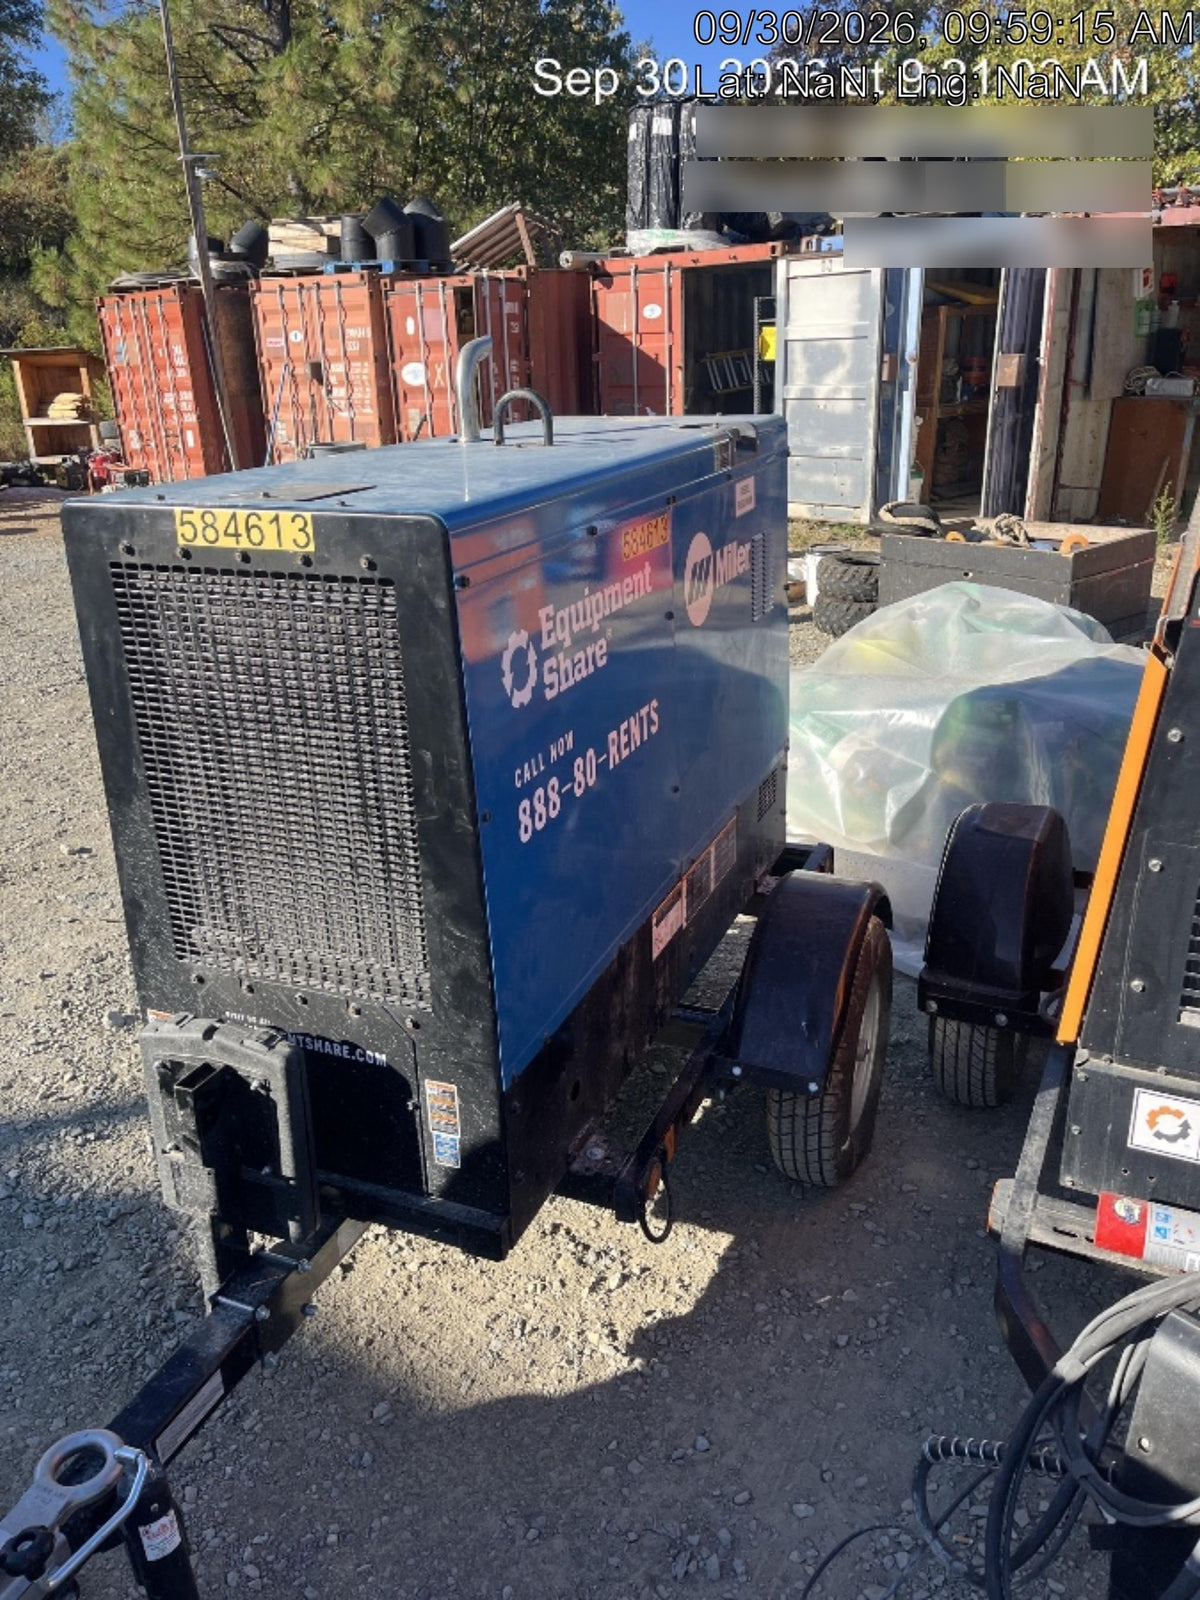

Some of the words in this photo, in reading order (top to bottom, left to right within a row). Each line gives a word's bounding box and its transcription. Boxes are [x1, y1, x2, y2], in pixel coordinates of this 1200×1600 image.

[180, 510, 311, 549] 584613
[715, 541, 751, 589] Miller
[538, 561, 653, 650] Equipment
[515, 753, 545, 788] CALL
[550, 730, 574, 764] NOW
[518, 698, 659, 843] 888-80-RENTS
[287, 1031, 387, 1067] NTSHARE.COM
